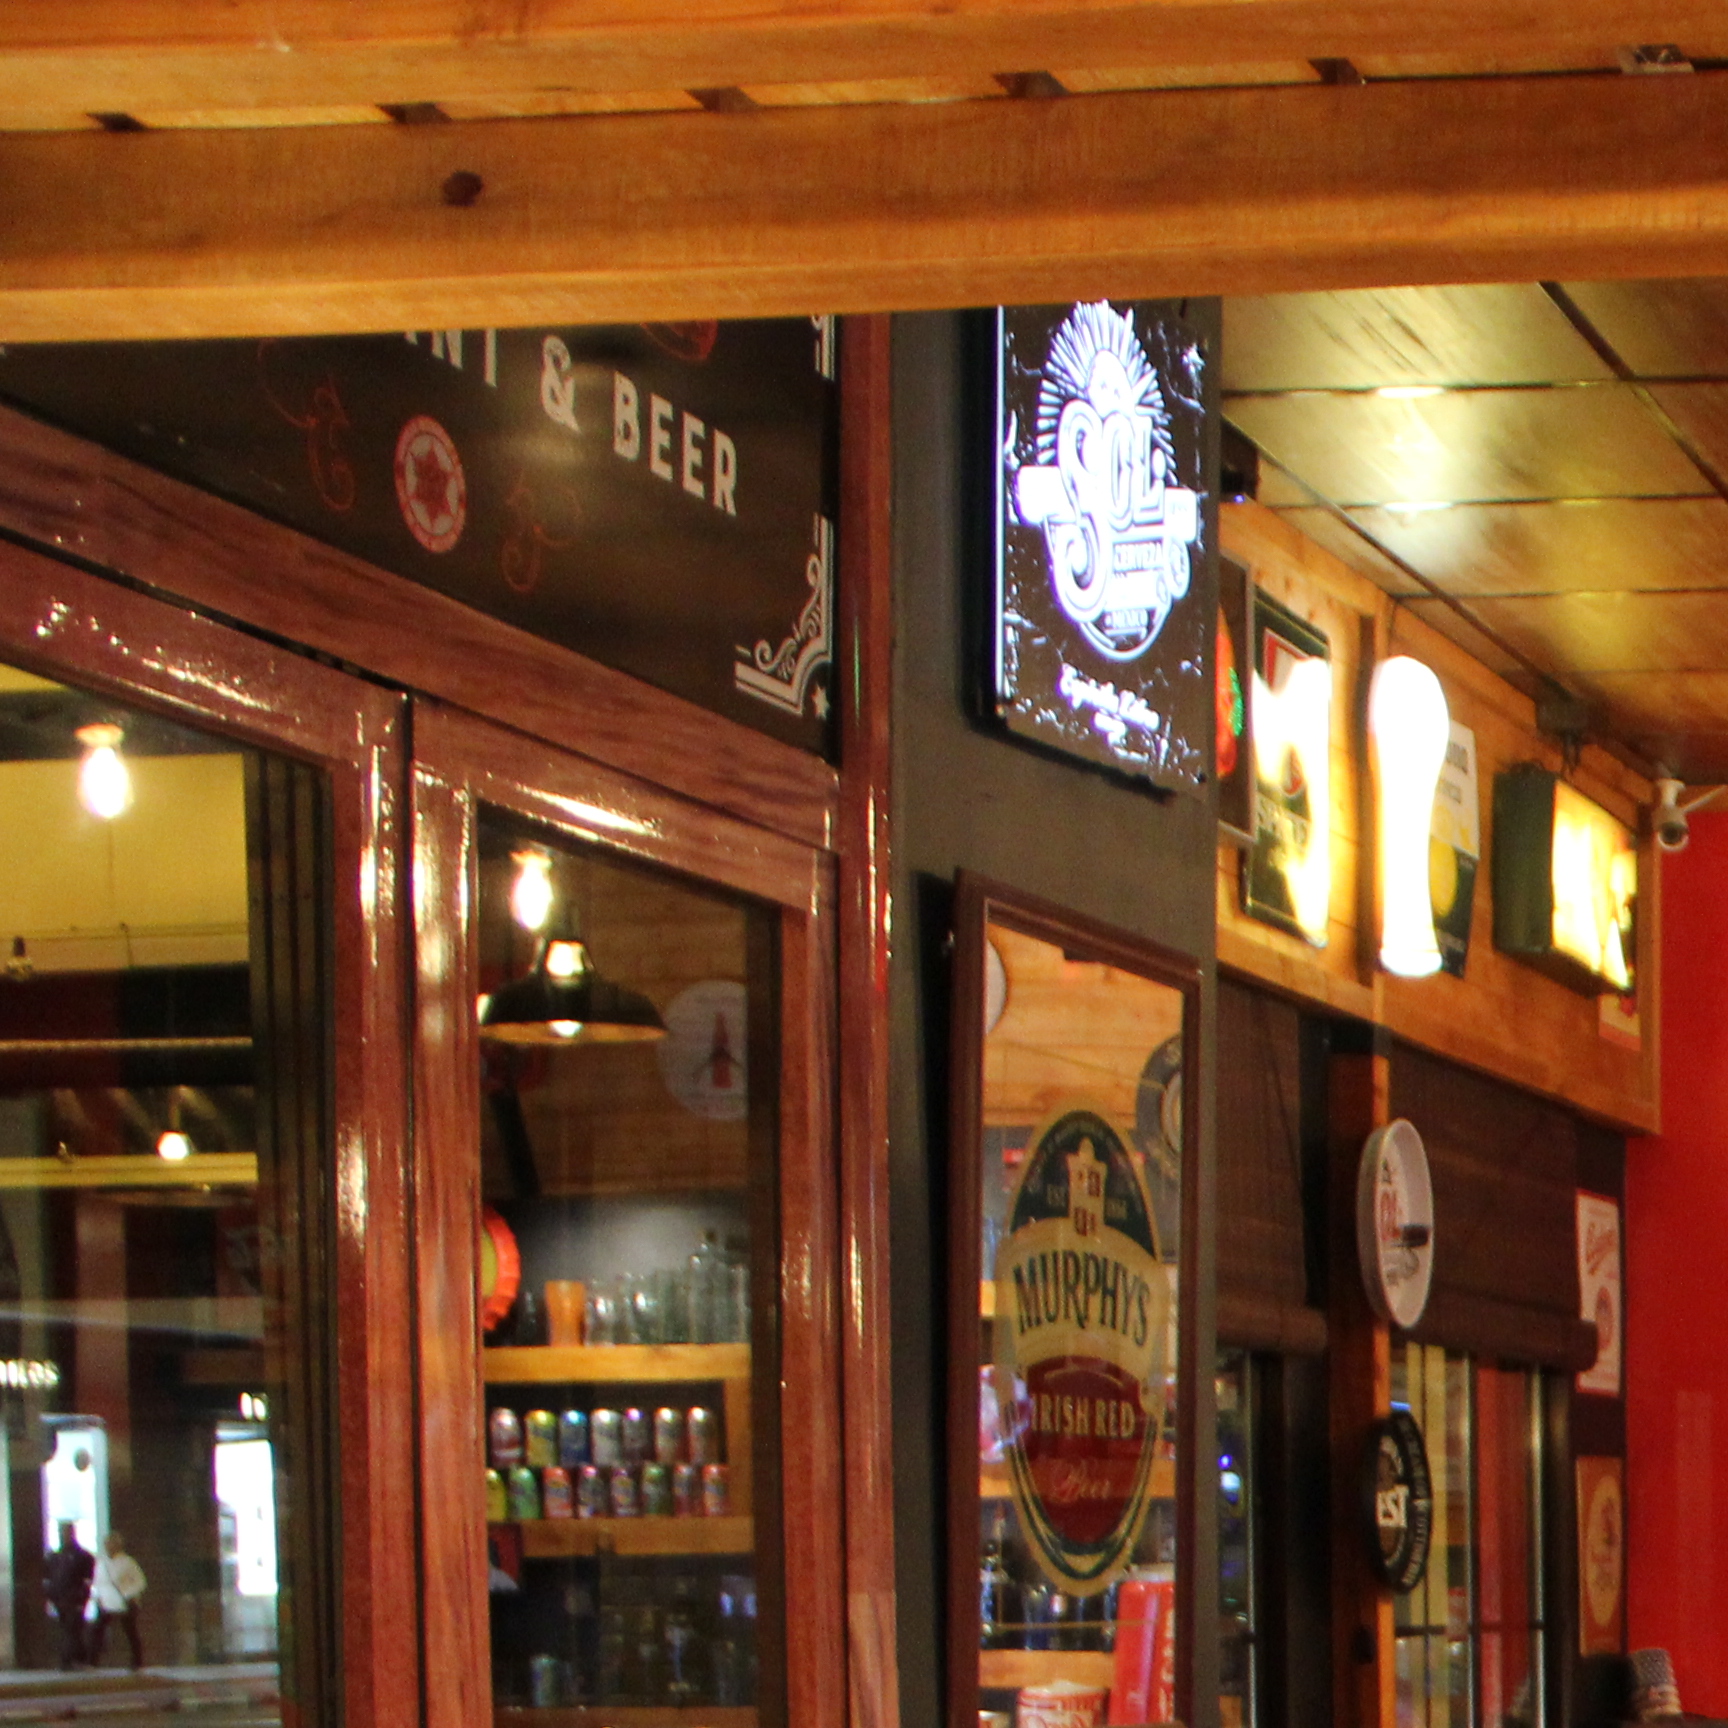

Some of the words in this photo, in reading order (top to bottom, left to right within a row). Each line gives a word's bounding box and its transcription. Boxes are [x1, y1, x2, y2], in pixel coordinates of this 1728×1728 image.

[541, 335, 582, 434] &
[613, 371, 737, 517] BEER
[1031, 1396, 1090, 1436] IRISH
[1095, 1399, 1136, 1439] RED
